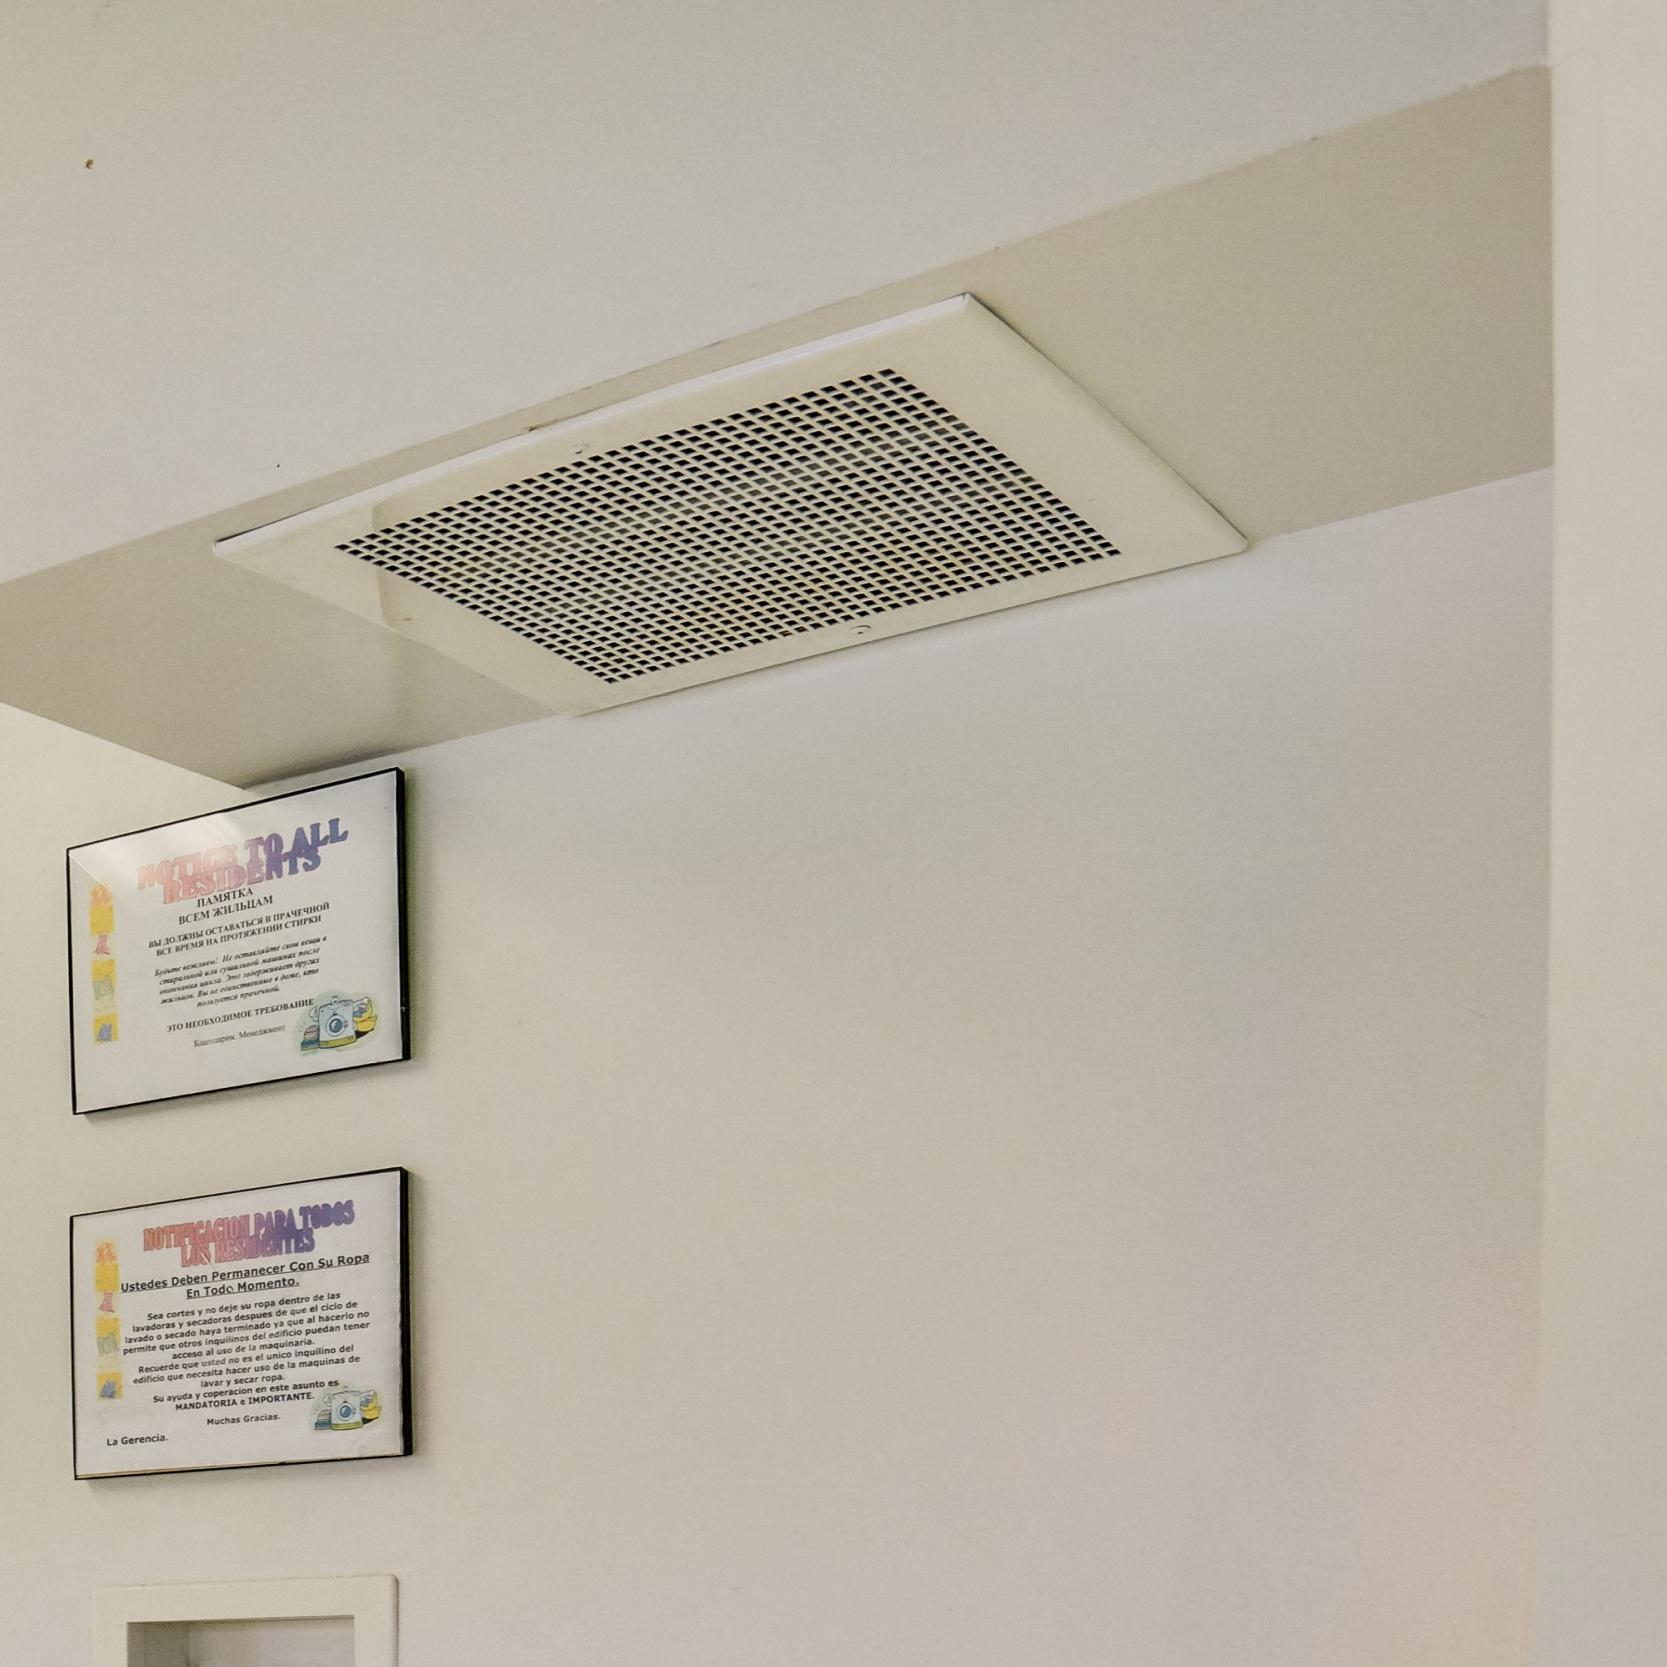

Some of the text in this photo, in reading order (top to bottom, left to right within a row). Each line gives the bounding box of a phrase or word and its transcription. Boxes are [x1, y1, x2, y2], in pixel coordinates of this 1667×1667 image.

[137, 815, 348, 889] NOTICE TO ALL
[162, 844, 321, 905] RESIDENTS
[178, 895, 273, 925] ВСЕМ ЖИЛЬЦАМ
[196, 887, 254, 907] ПАМЯТКА
[148, 902, 330, 948] ВЫ ДОЛЖНЫ ОСТАВАТЬСЯ В ПРАЧЕЧНОЙ
[155, 914, 321, 956] ВСЕ ВРЕМЯ НА ПРОТЯЖЕНИИ СТИРКИ
[165, 997, 315, 1032] ЭТО НЕОБХОДИМОЕ ТРЕБОВАНИЕ
[142, 1199, 355, 1251] NOTIFICACION PARA TODOS
[180, 1226, 315, 1267] LOS RESIDENTES
[121, 1252, 369, 1291] Ustedes Deben Permanecer Con Su Ropa
[186, 1276, 298, 1298] En Todo Momento.
[259, 1338, 314, 1352] maquinaria.
[175, 1399, 238, 1410] MANDATORIA
[248, 1392, 314, 1404] IMPORTANTE.
[206, 1413, 280, 1425] Muchas Gracias.
[121, 1434, 168, 1444] Gerencia.
